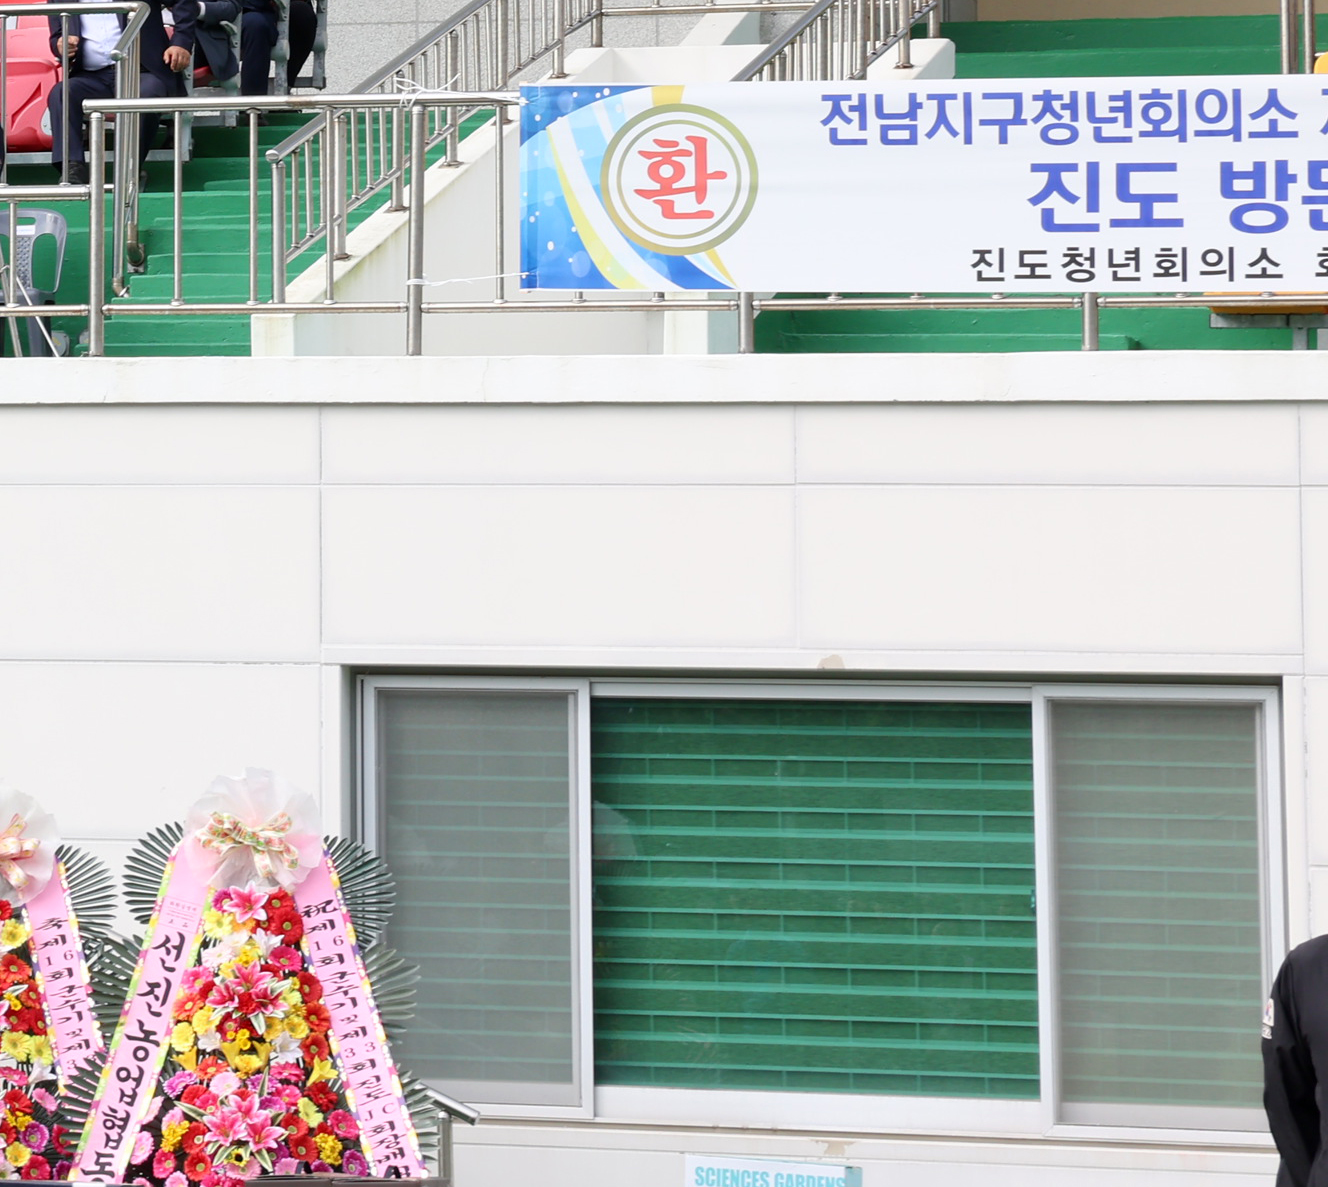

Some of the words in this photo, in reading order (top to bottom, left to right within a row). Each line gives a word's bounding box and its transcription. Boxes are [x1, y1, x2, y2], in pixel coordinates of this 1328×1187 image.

[820, 87, 1299, 147] 전남지구청년회의소
[632, 136, 728, 220] 환
[1026, 159, 1185, 234] 진도
[970, 246, 1284, 283] 진도청년회의소
[695, 1166, 769, 1187] SCIENCES
[775, 1172, 845, 1187] GARDENS
